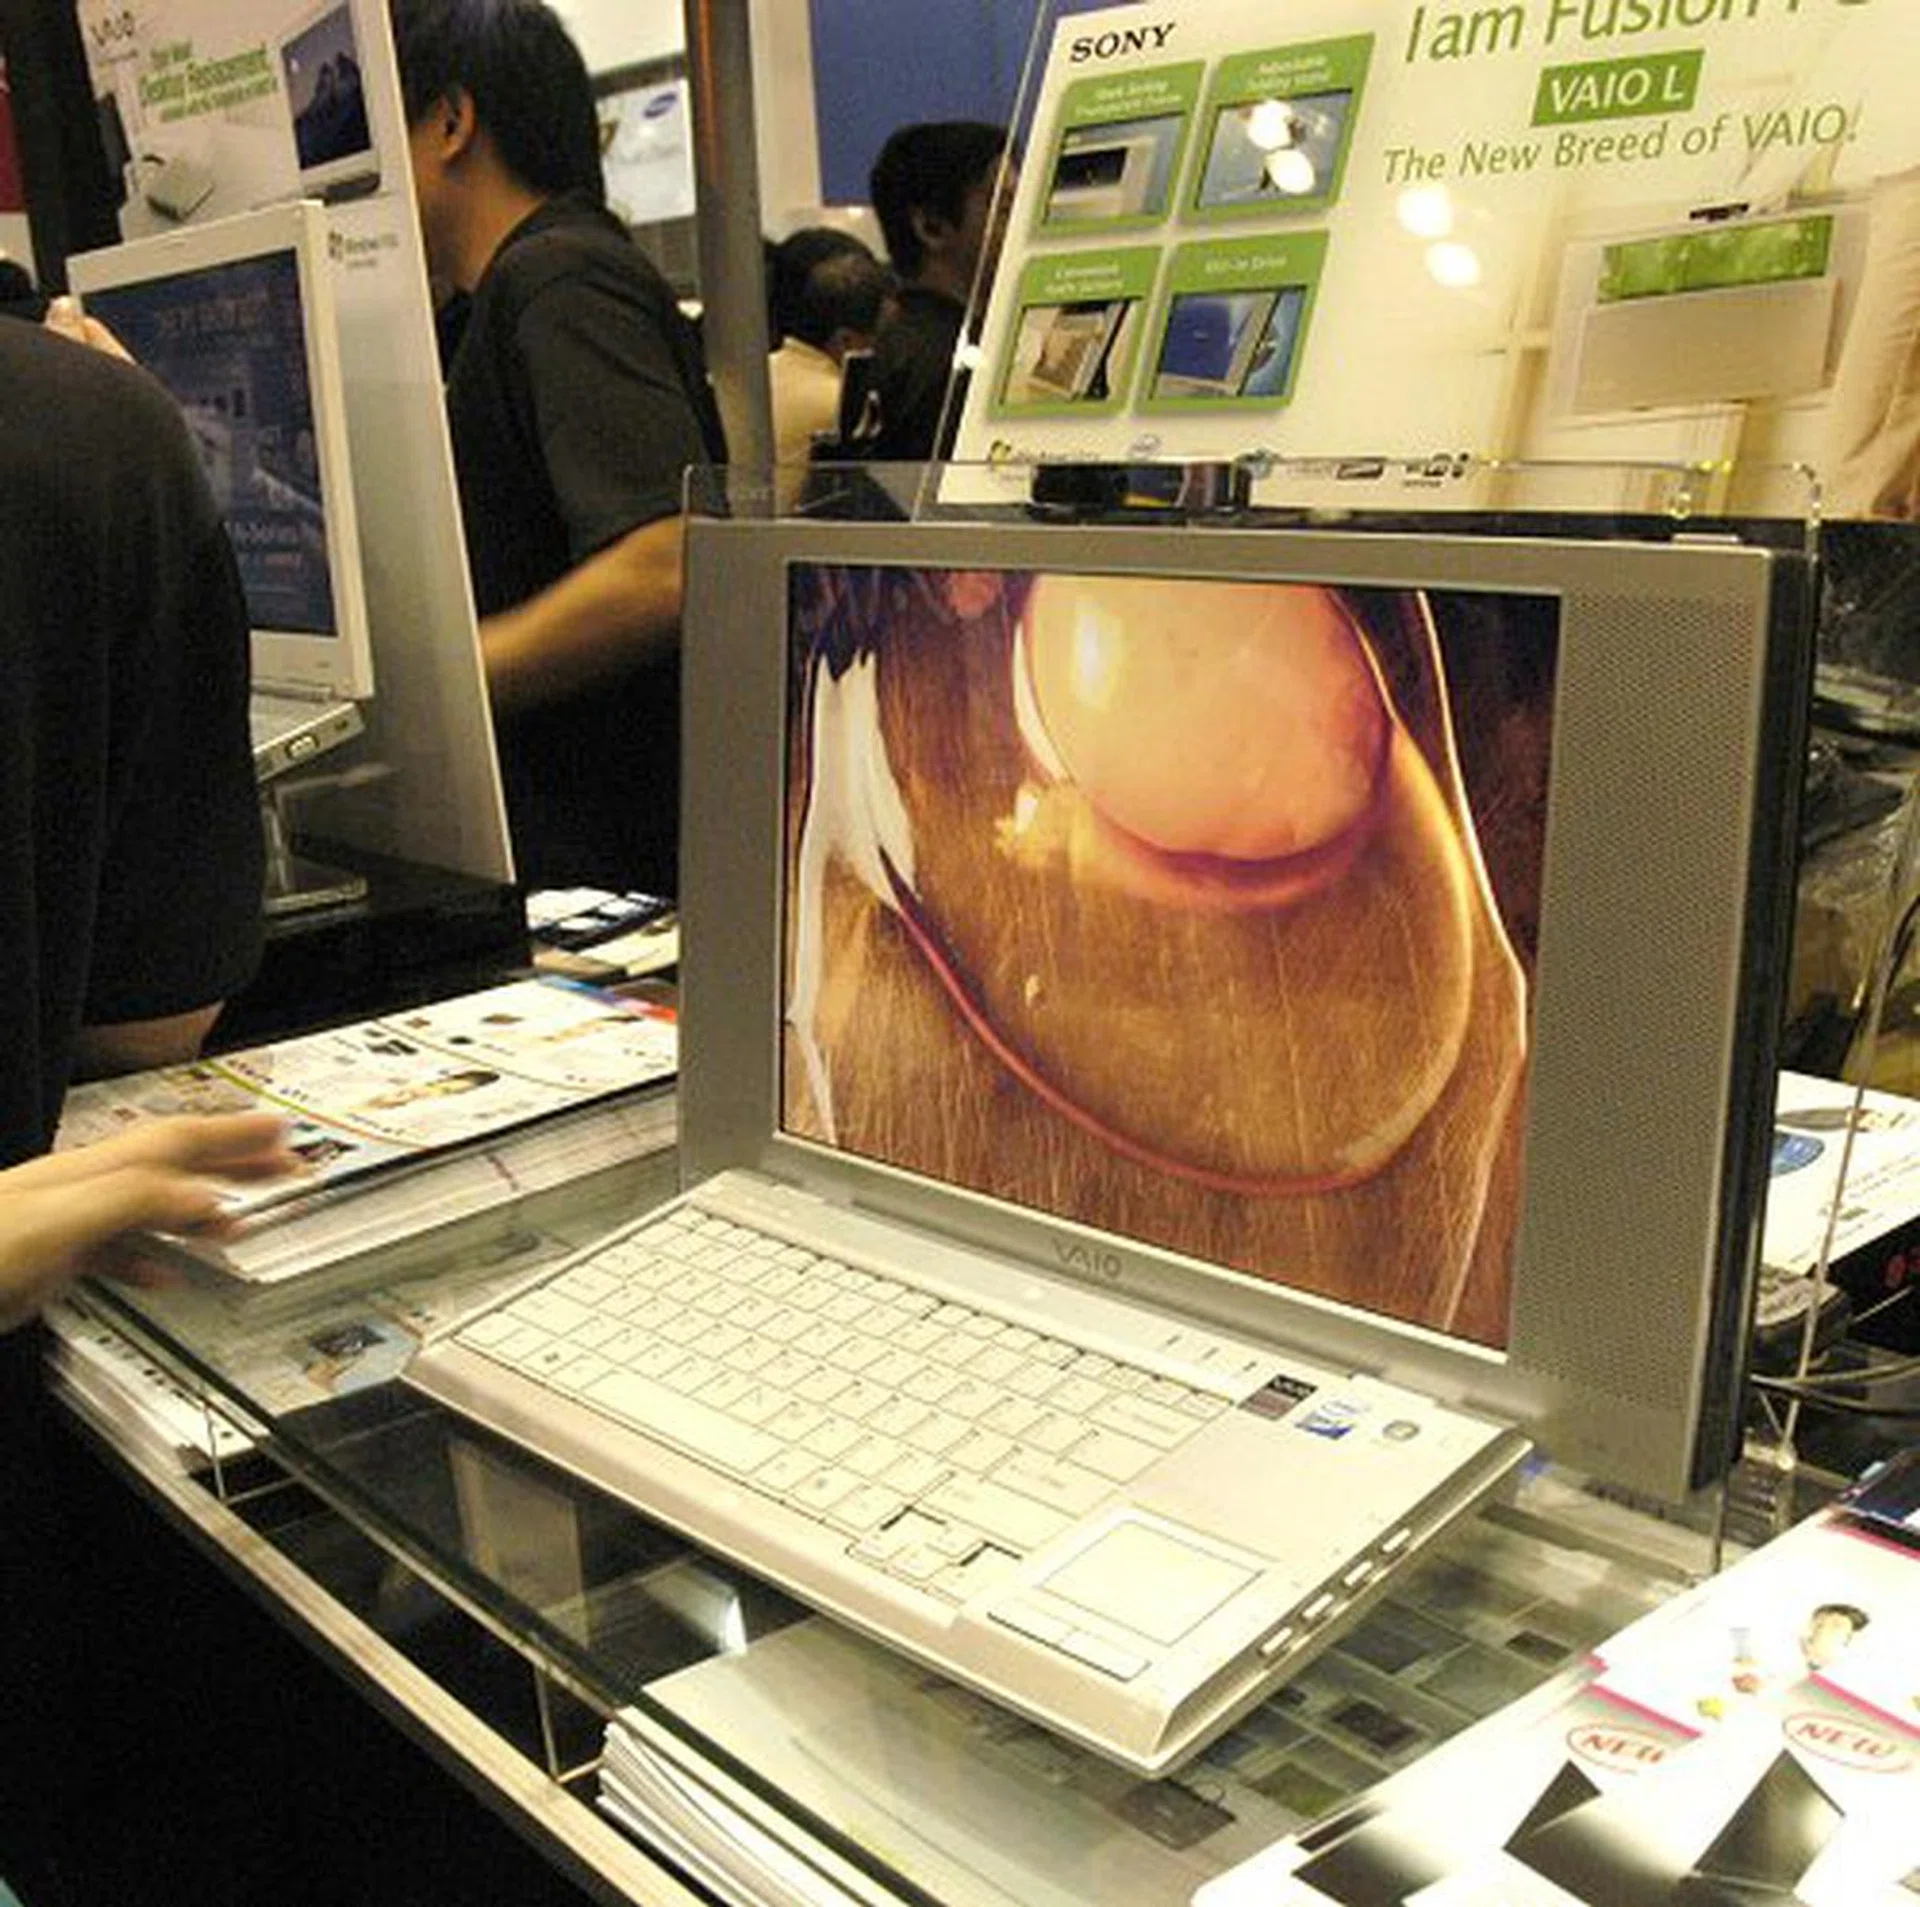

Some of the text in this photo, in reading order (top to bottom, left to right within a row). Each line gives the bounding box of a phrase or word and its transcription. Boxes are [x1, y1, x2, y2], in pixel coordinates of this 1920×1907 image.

[1070, 22, 1176, 63] SONY
[1551, 65, 1686, 114] VAIO L
[1383, 99, 1863, 183] The New Breed of VAIO!
[1052, 1236, 1123, 1279] VAIO
